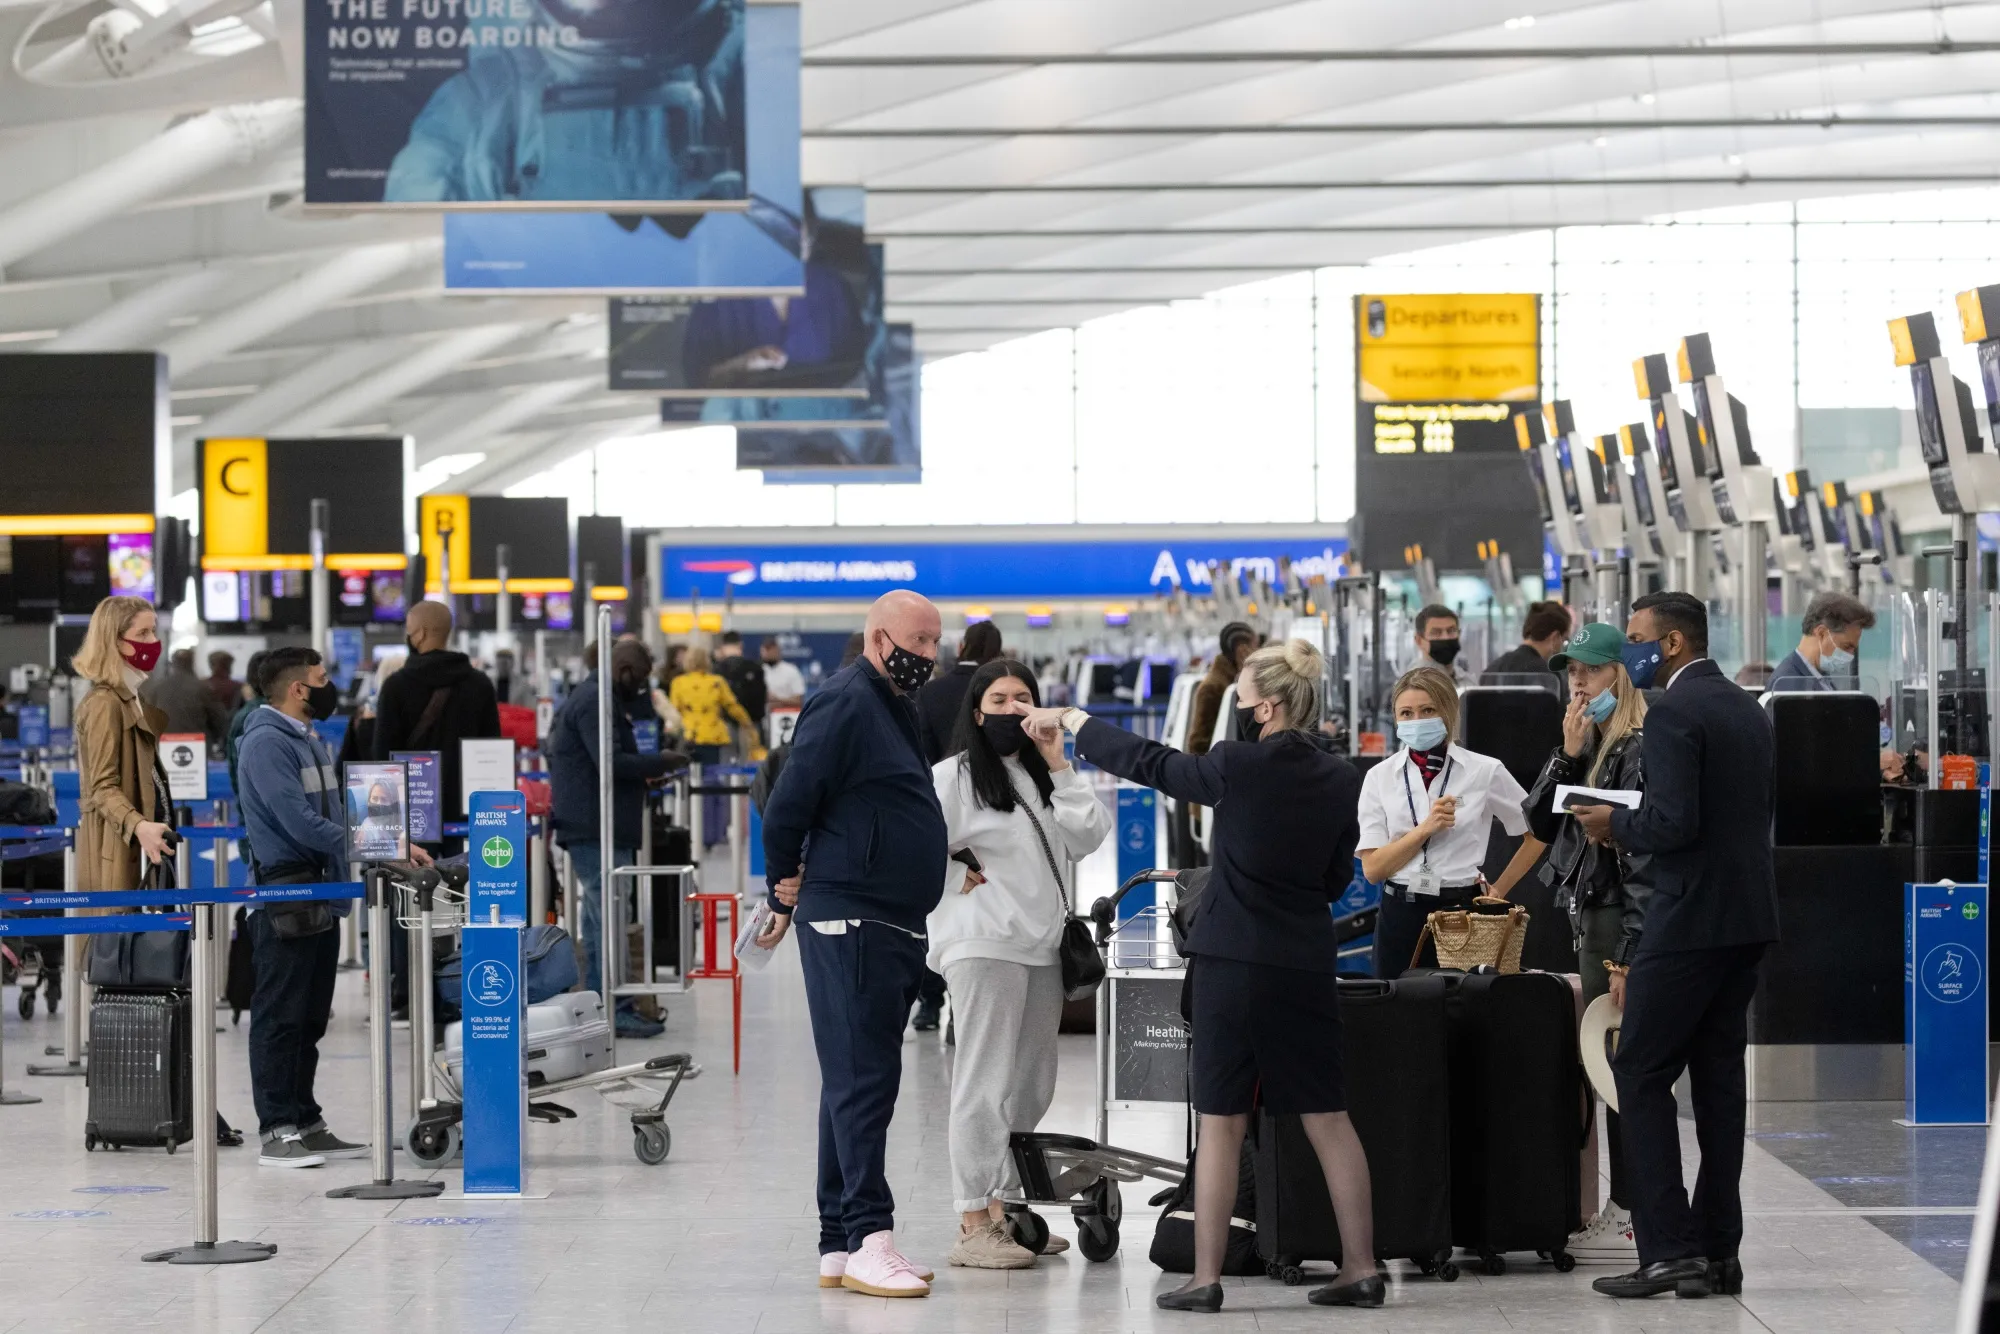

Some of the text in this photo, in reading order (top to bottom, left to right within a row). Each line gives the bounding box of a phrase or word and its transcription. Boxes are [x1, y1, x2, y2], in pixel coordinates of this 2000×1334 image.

[330, 0, 534, 19] THE FUTURE
[328, 26, 580, 48] NOW BOARDING
[1391, 307, 1520, 328] Departures
[1391, 364, 1522, 380] Security North
[221, 457, 250, 496] C
[1150, 550, 1181, 586] A
[1186, 557, 1275, 586] wrm
[475, 811, 507, 819] BRITISH
[484, 848, 511, 857] Dettol
[477, 881, 496, 889] Taking
[286, 888, 313, 896] AIRWAYS
[490, 889, 516, 897] together
[1146, 1025, 1185, 1038] Heathr
[1133, 1040, 1159, 1049] Making
[1160, 1041, 1179, 1050] every
